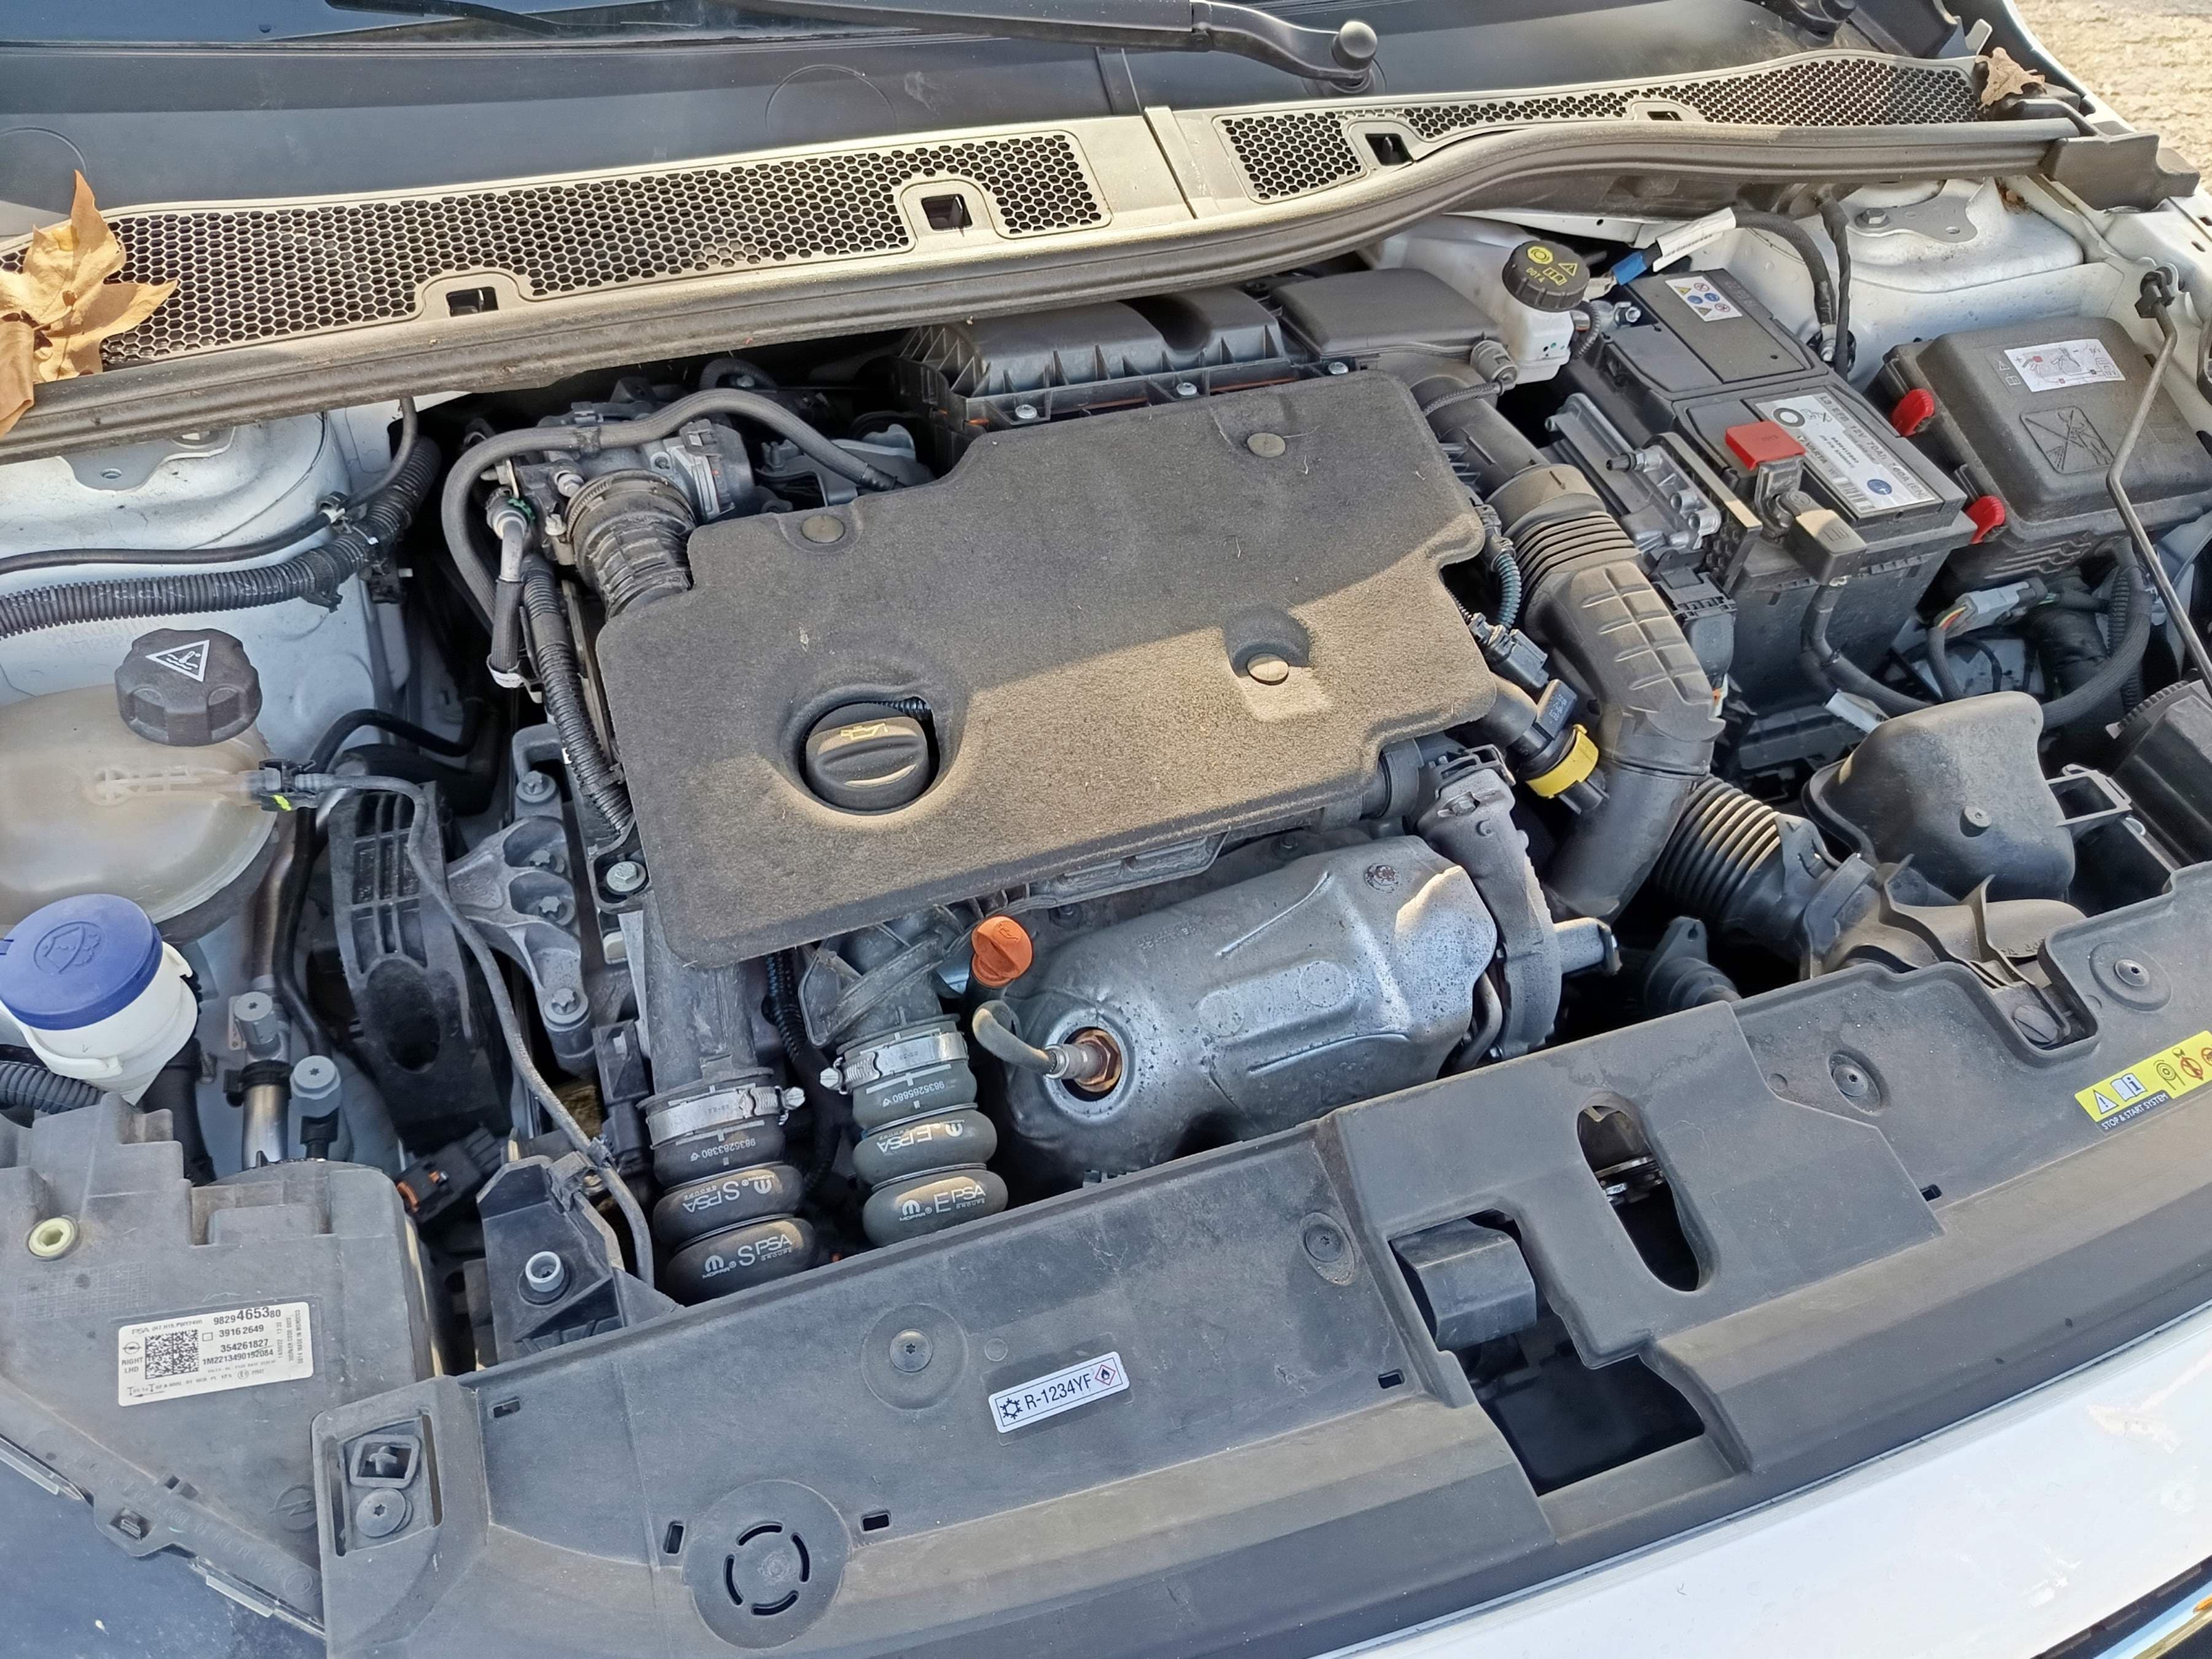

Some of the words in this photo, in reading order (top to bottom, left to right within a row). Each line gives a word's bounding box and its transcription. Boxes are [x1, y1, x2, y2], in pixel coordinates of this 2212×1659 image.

[1526, 267, 1540, 278] DOT
[1832, 407, 1849, 422] EFB
[1851, 426, 1868, 438] 12V
[1867, 441, 1887, 460] 70Ah
[1806, 442, 1827, 464] VARTA
[892, 1080, 945, 1103] 9835265880
[2101, 1116, 2119, 1130] STOP
[2123, 1107, 2144, 1120] START
[2143, 1092, 2168, 1110] SYSTEM
[702, 1138, 756, 1159] 9835283380
[877, 1131, 914, 1153] PSA
[723, 1180, 740, 1201] S
[933, 1191, 952, 1214] E
[951, 1184, 986, 1204] PSA
[682, 1191, 722, 1213] PSA
[737, 1245, 756, 1266] S
[755, 1233, 793, 1255] PSA
[220, 1339, 269, 1353] 354261827
[121, 1357, 144, 1366] RIGHT
[1024, 1373, 1092, 1410] R-1234YF
